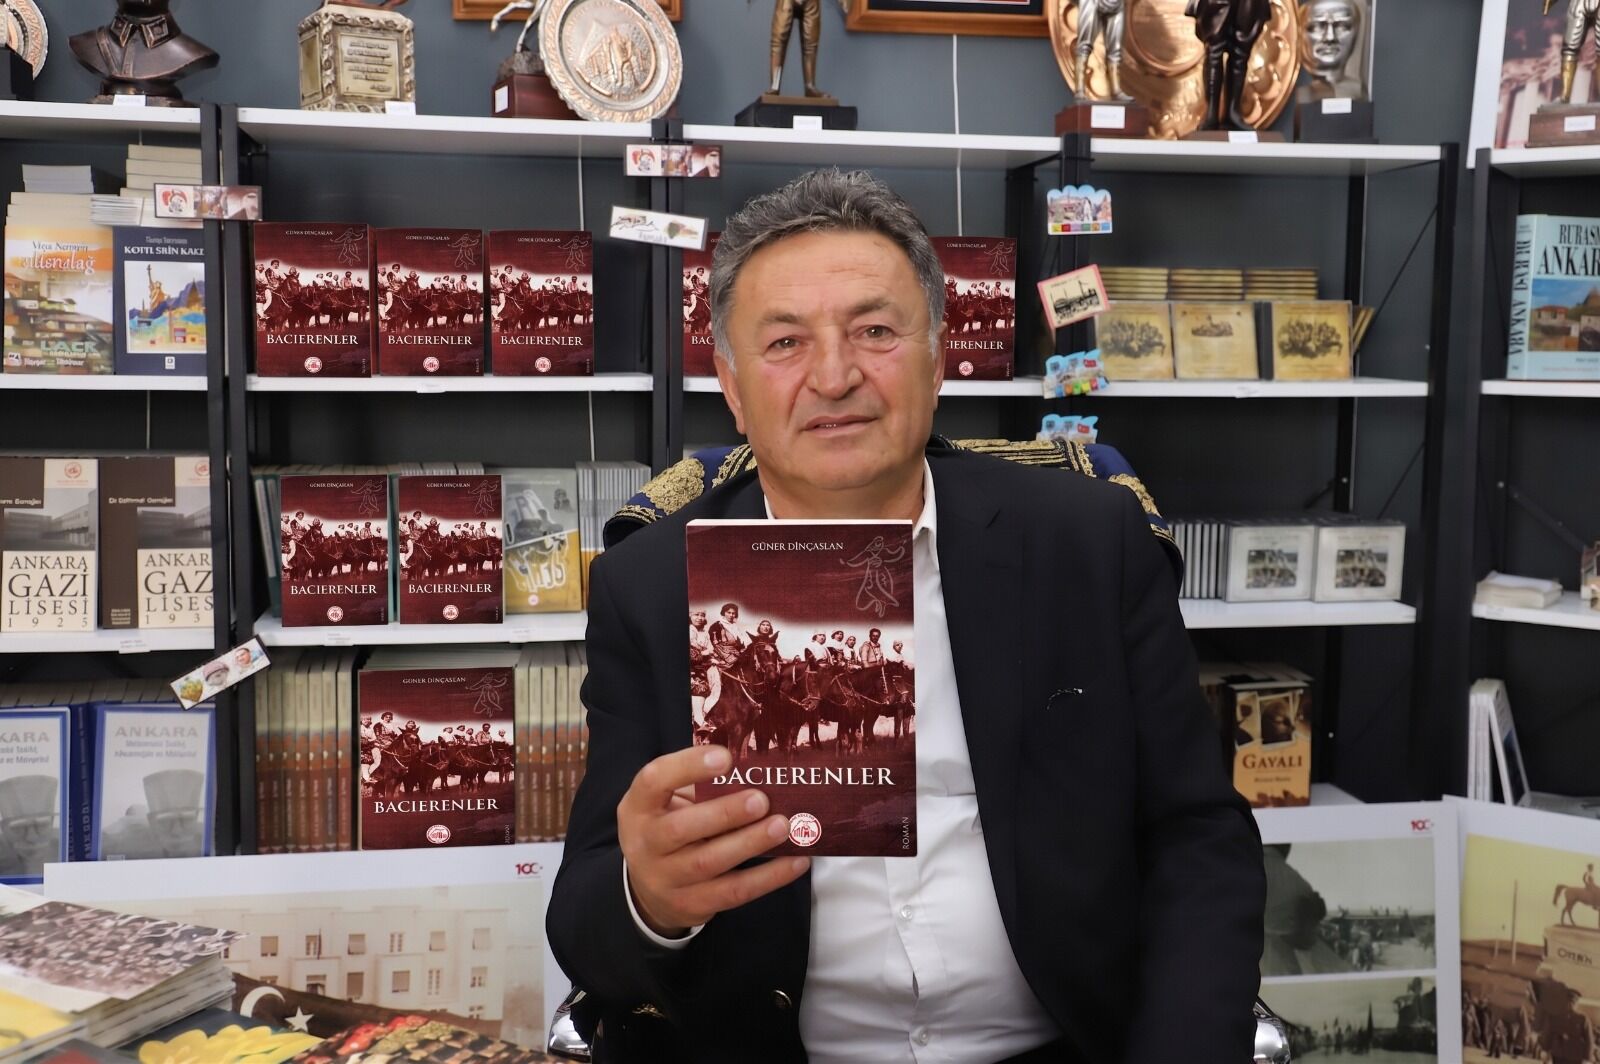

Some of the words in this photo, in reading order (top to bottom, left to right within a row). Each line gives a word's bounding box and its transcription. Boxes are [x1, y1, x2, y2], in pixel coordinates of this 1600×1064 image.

[266, 334, 359, 345] BACIERENLER
[387, 335, 473, 345] BACIERENLER
[500, 335, 584, 346] BACIERENLER
[945, 340, 1004, 350] IERENLER
[751, 541, 786, 551] GÜNER
[788, 541, 844, 552] DİNÇASLAN
[9, 555, 88, 569] ANKARA
[144, 552, 211, 567] ANKAR
[8, 568, 89, 598] GAZİ
[144, 570, 215, 595] GAZ
[290, 584, 377, 595] BACIERENLER
[408, 583, 493, 594] BACIERENLER
[114, 726, 199, 737] ANKARA
[374, 798, 500, 814] BACIERENLER
[902, 816, 910, 850] ROMAN
